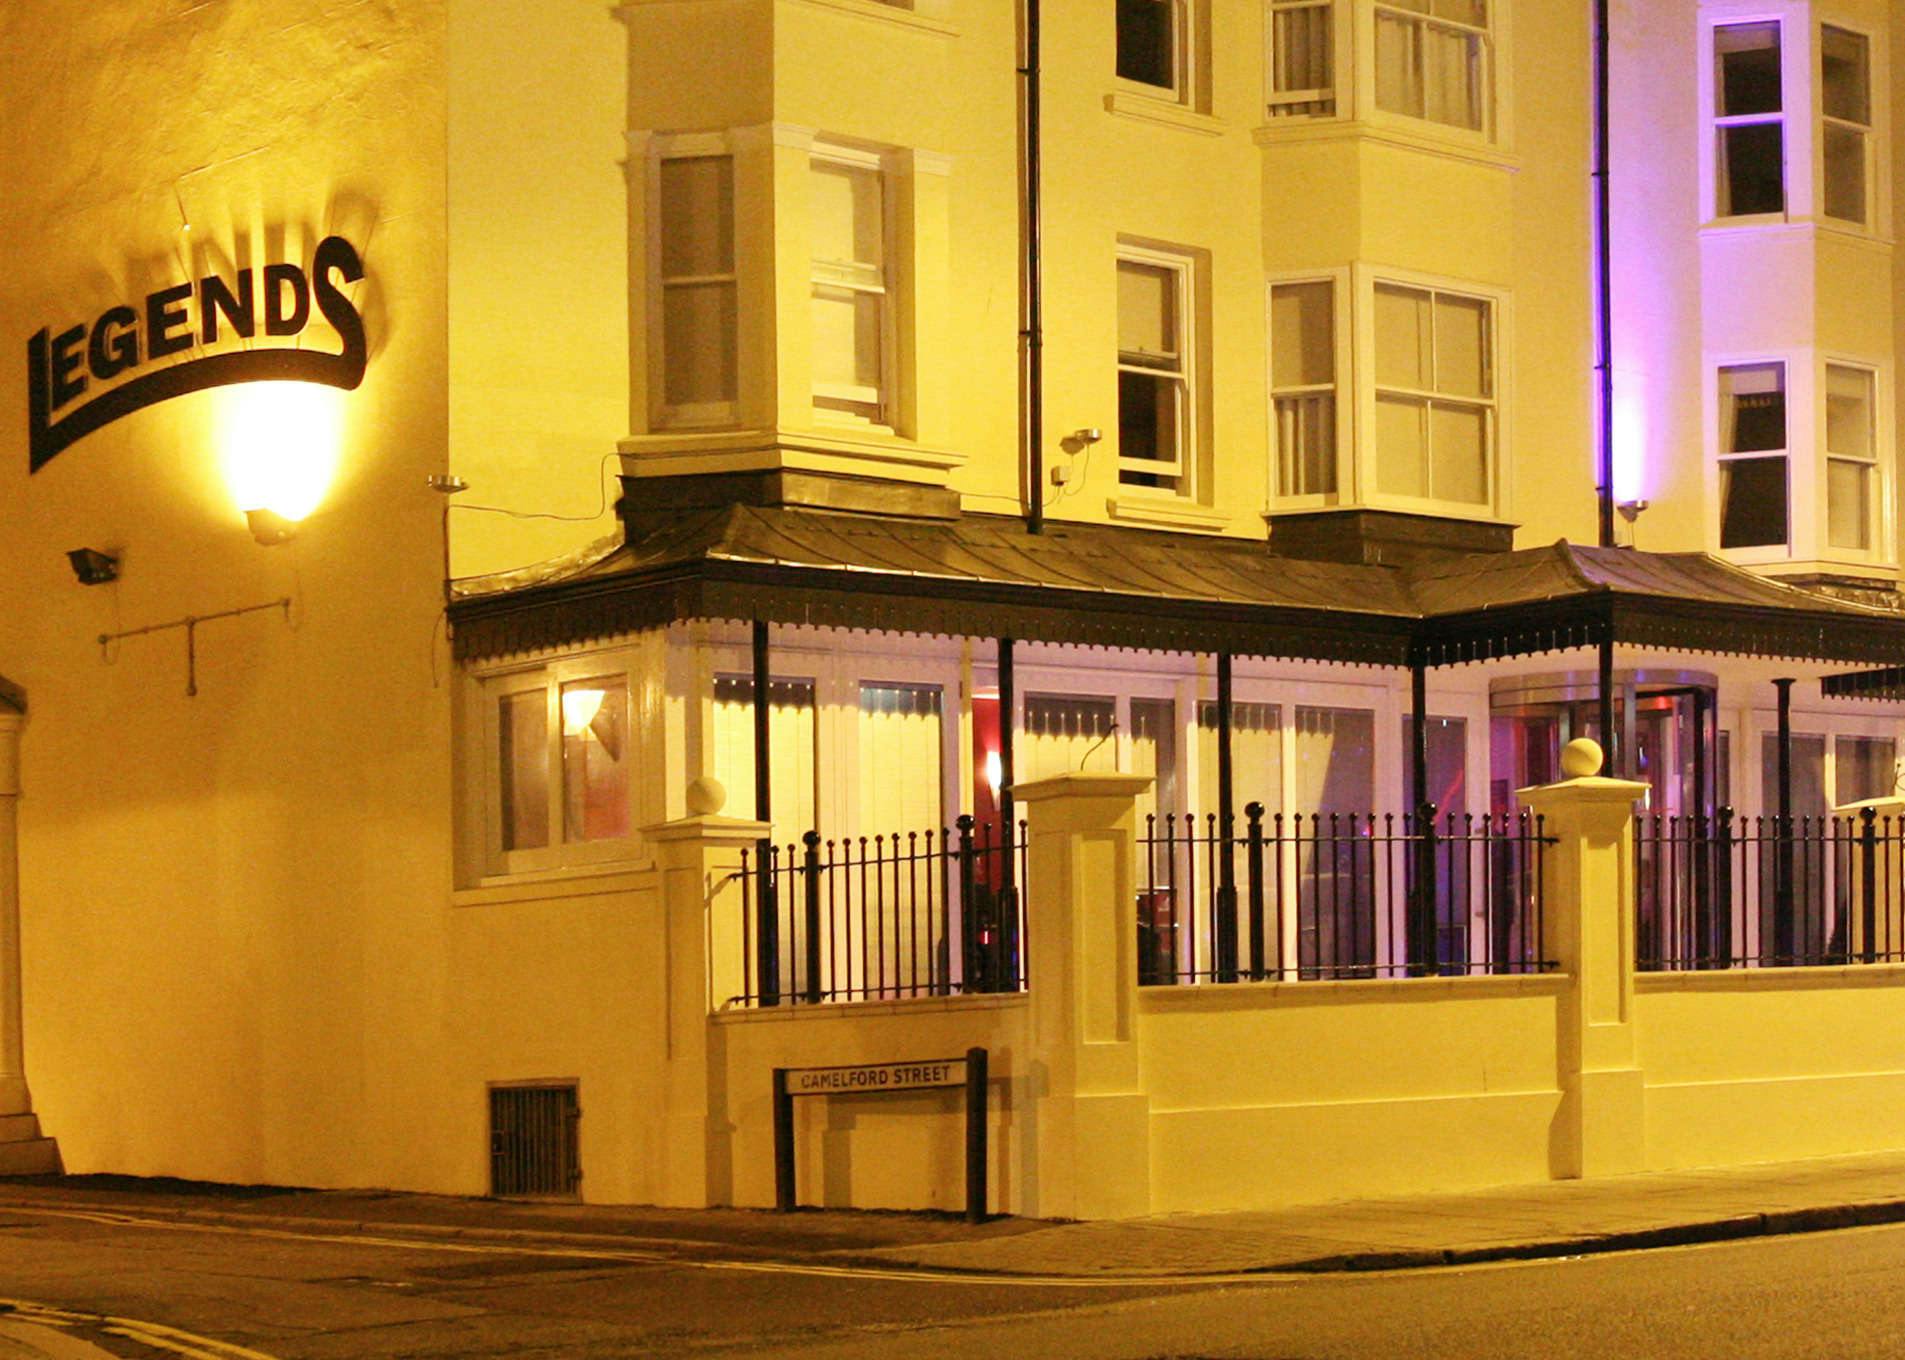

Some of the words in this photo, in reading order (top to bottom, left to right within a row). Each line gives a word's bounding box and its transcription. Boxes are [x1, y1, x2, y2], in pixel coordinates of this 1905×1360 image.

[28, 236, 367, 475] LEGENDS
[801, 1069, 888, 1088] CAMELFORD
[893, 1066, 950, 1083] STREET
